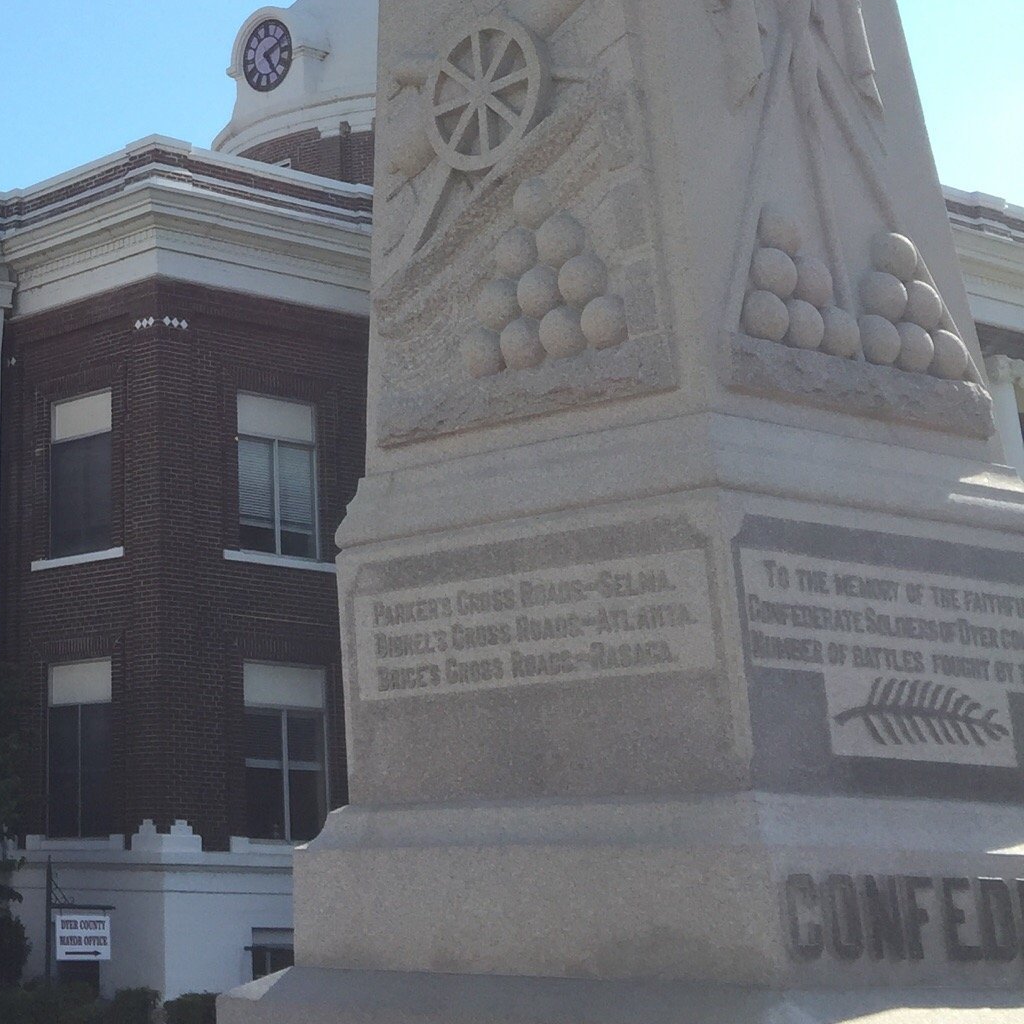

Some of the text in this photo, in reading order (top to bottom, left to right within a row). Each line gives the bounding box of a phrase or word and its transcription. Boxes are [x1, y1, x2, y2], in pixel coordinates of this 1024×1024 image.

[762, 559, 789, 589] TO
[795, 569, 830, 594] THE
[906, 582, 923, 605] OF
[929, 586, 960, 610] THE
[457, 589, 515, 615] CROSS
[748, 593, 864, 634] CONFEDERATE
[452, 623, 511, 650] CROSS
[750, 629, 824, 664] NUMBER
[828, 641, 848, 666] OF
[852, 644, 924, 674] BATTLES
[445, 657, 504, 684] CROSS
[60, 919, 106, 930] DYER COUNTY
[784, 872, 1024, 963] CONFED
[59, 935, 108, 946] MAYOR OFFICE
